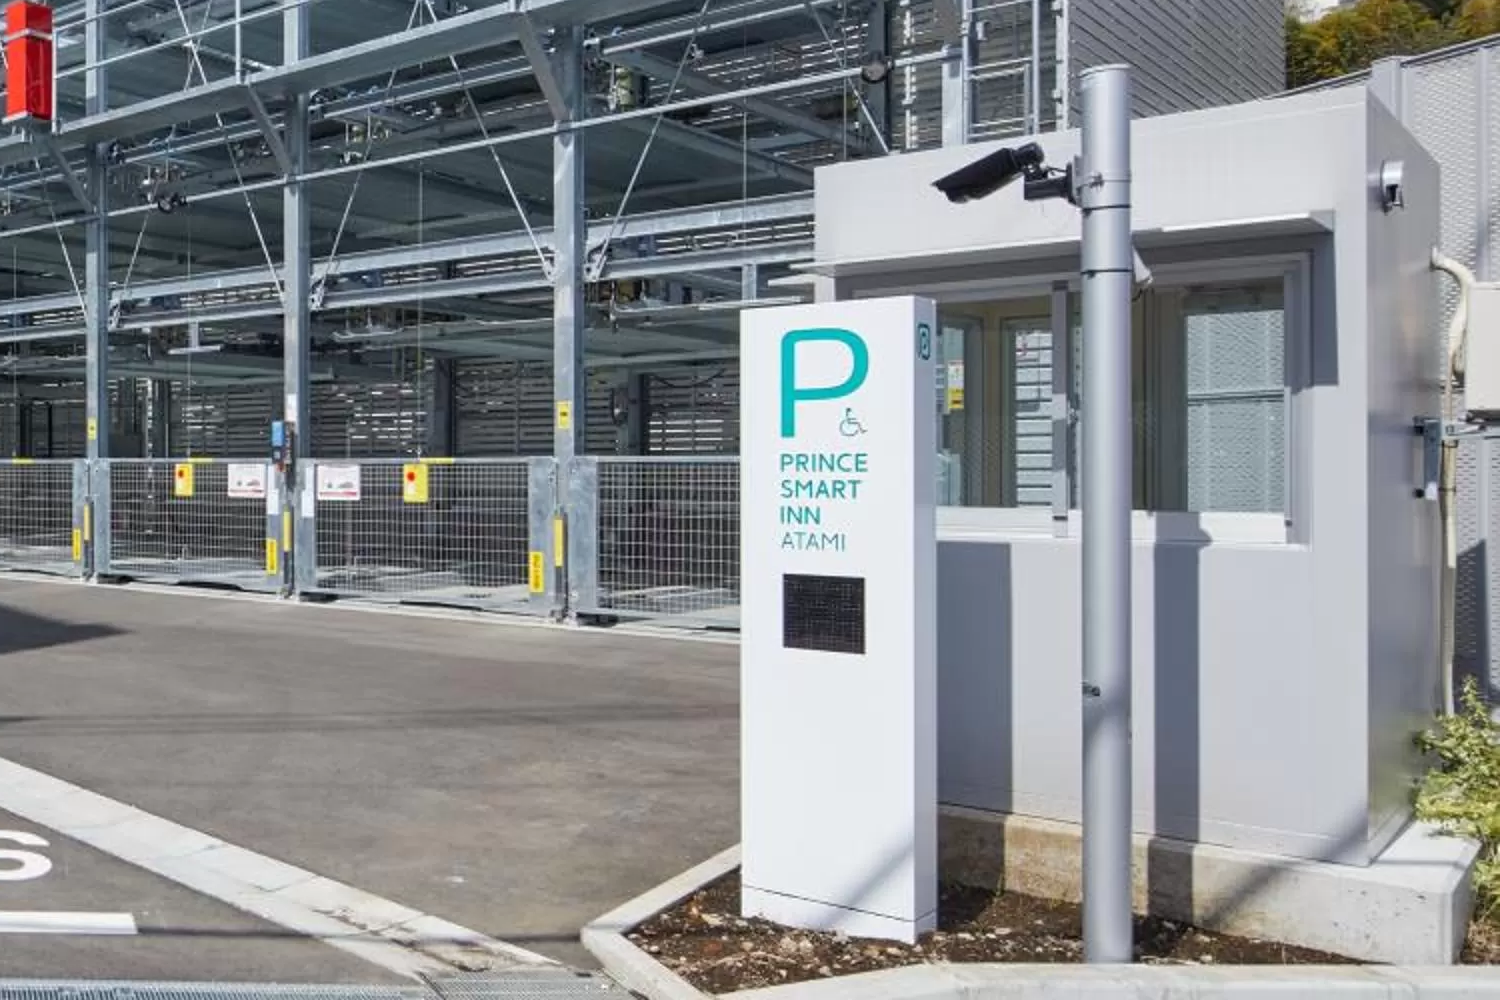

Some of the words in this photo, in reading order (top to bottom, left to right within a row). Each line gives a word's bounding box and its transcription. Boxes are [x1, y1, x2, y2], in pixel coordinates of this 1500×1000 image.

[780, 327, 870, 439] P
[780, 453, 869, 473] PRINCE
[780, 479, 863, 500] SMART
[780, 506, 821, 526] INN
[781, 532, 846, 552] ATAMI
